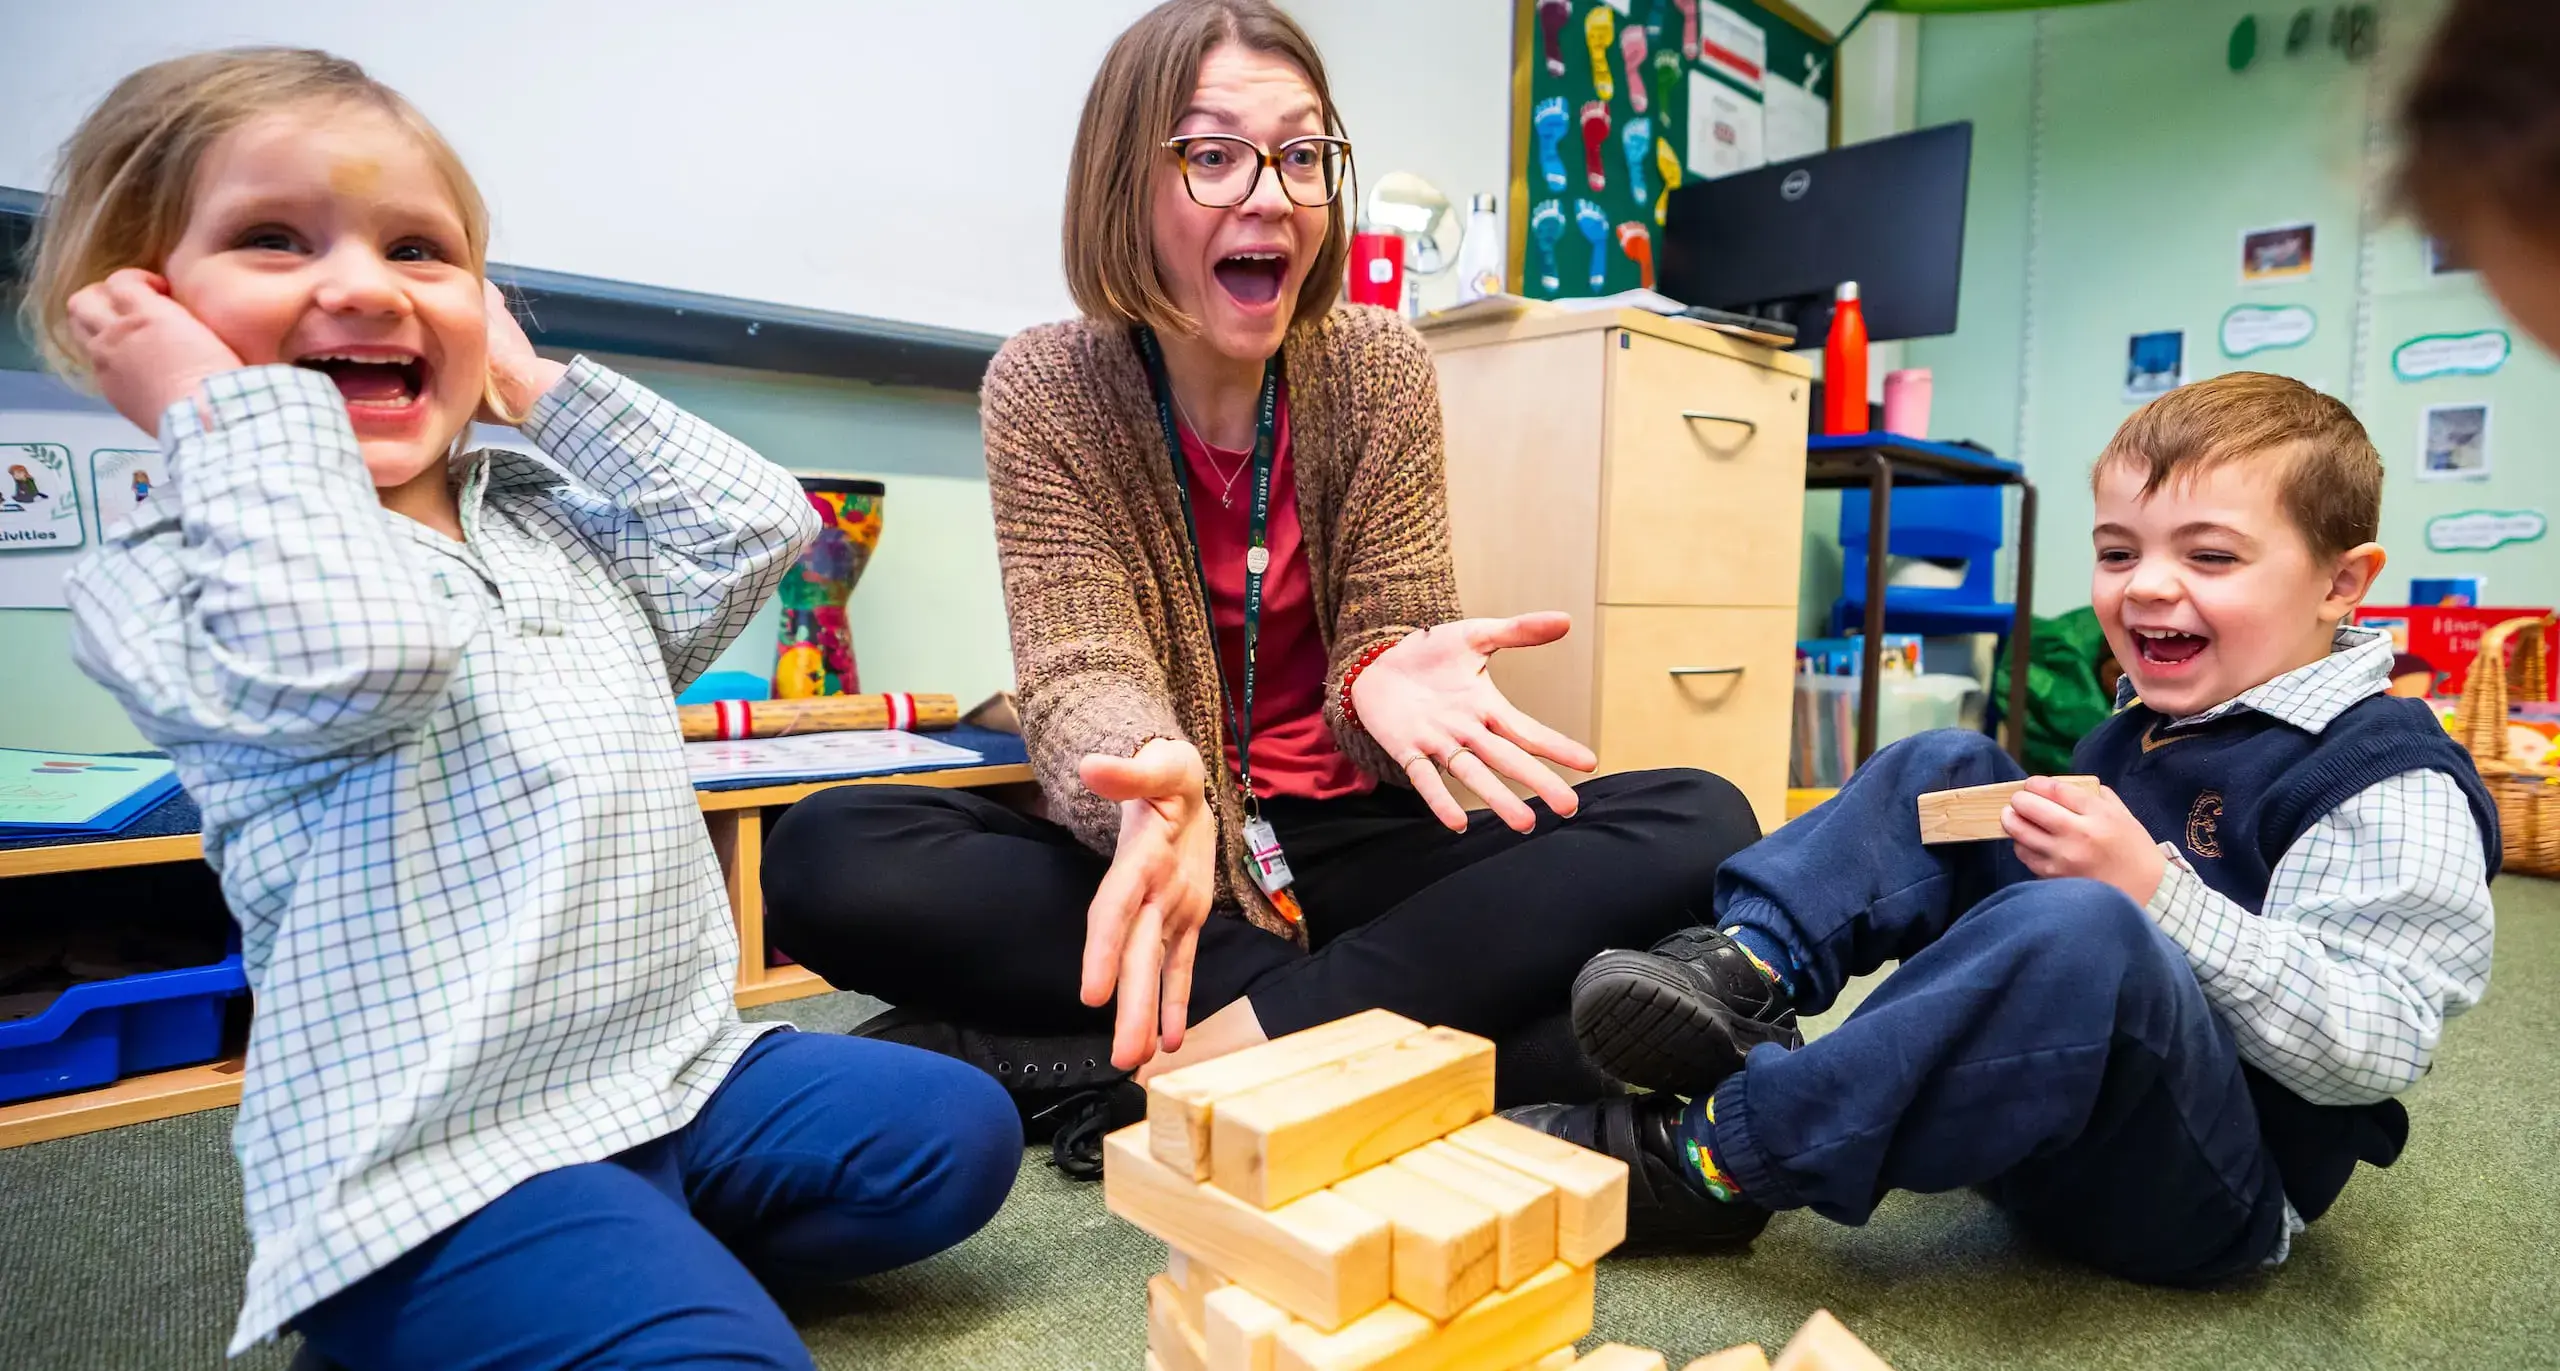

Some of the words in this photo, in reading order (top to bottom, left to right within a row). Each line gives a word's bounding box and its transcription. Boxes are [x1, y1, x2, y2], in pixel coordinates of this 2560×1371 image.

[1264, 374, 1277, 428] EMBLEY
[1257, 467, 1269, 521] EMBLEY
[1251, 575, 1261, 613] BLEY
